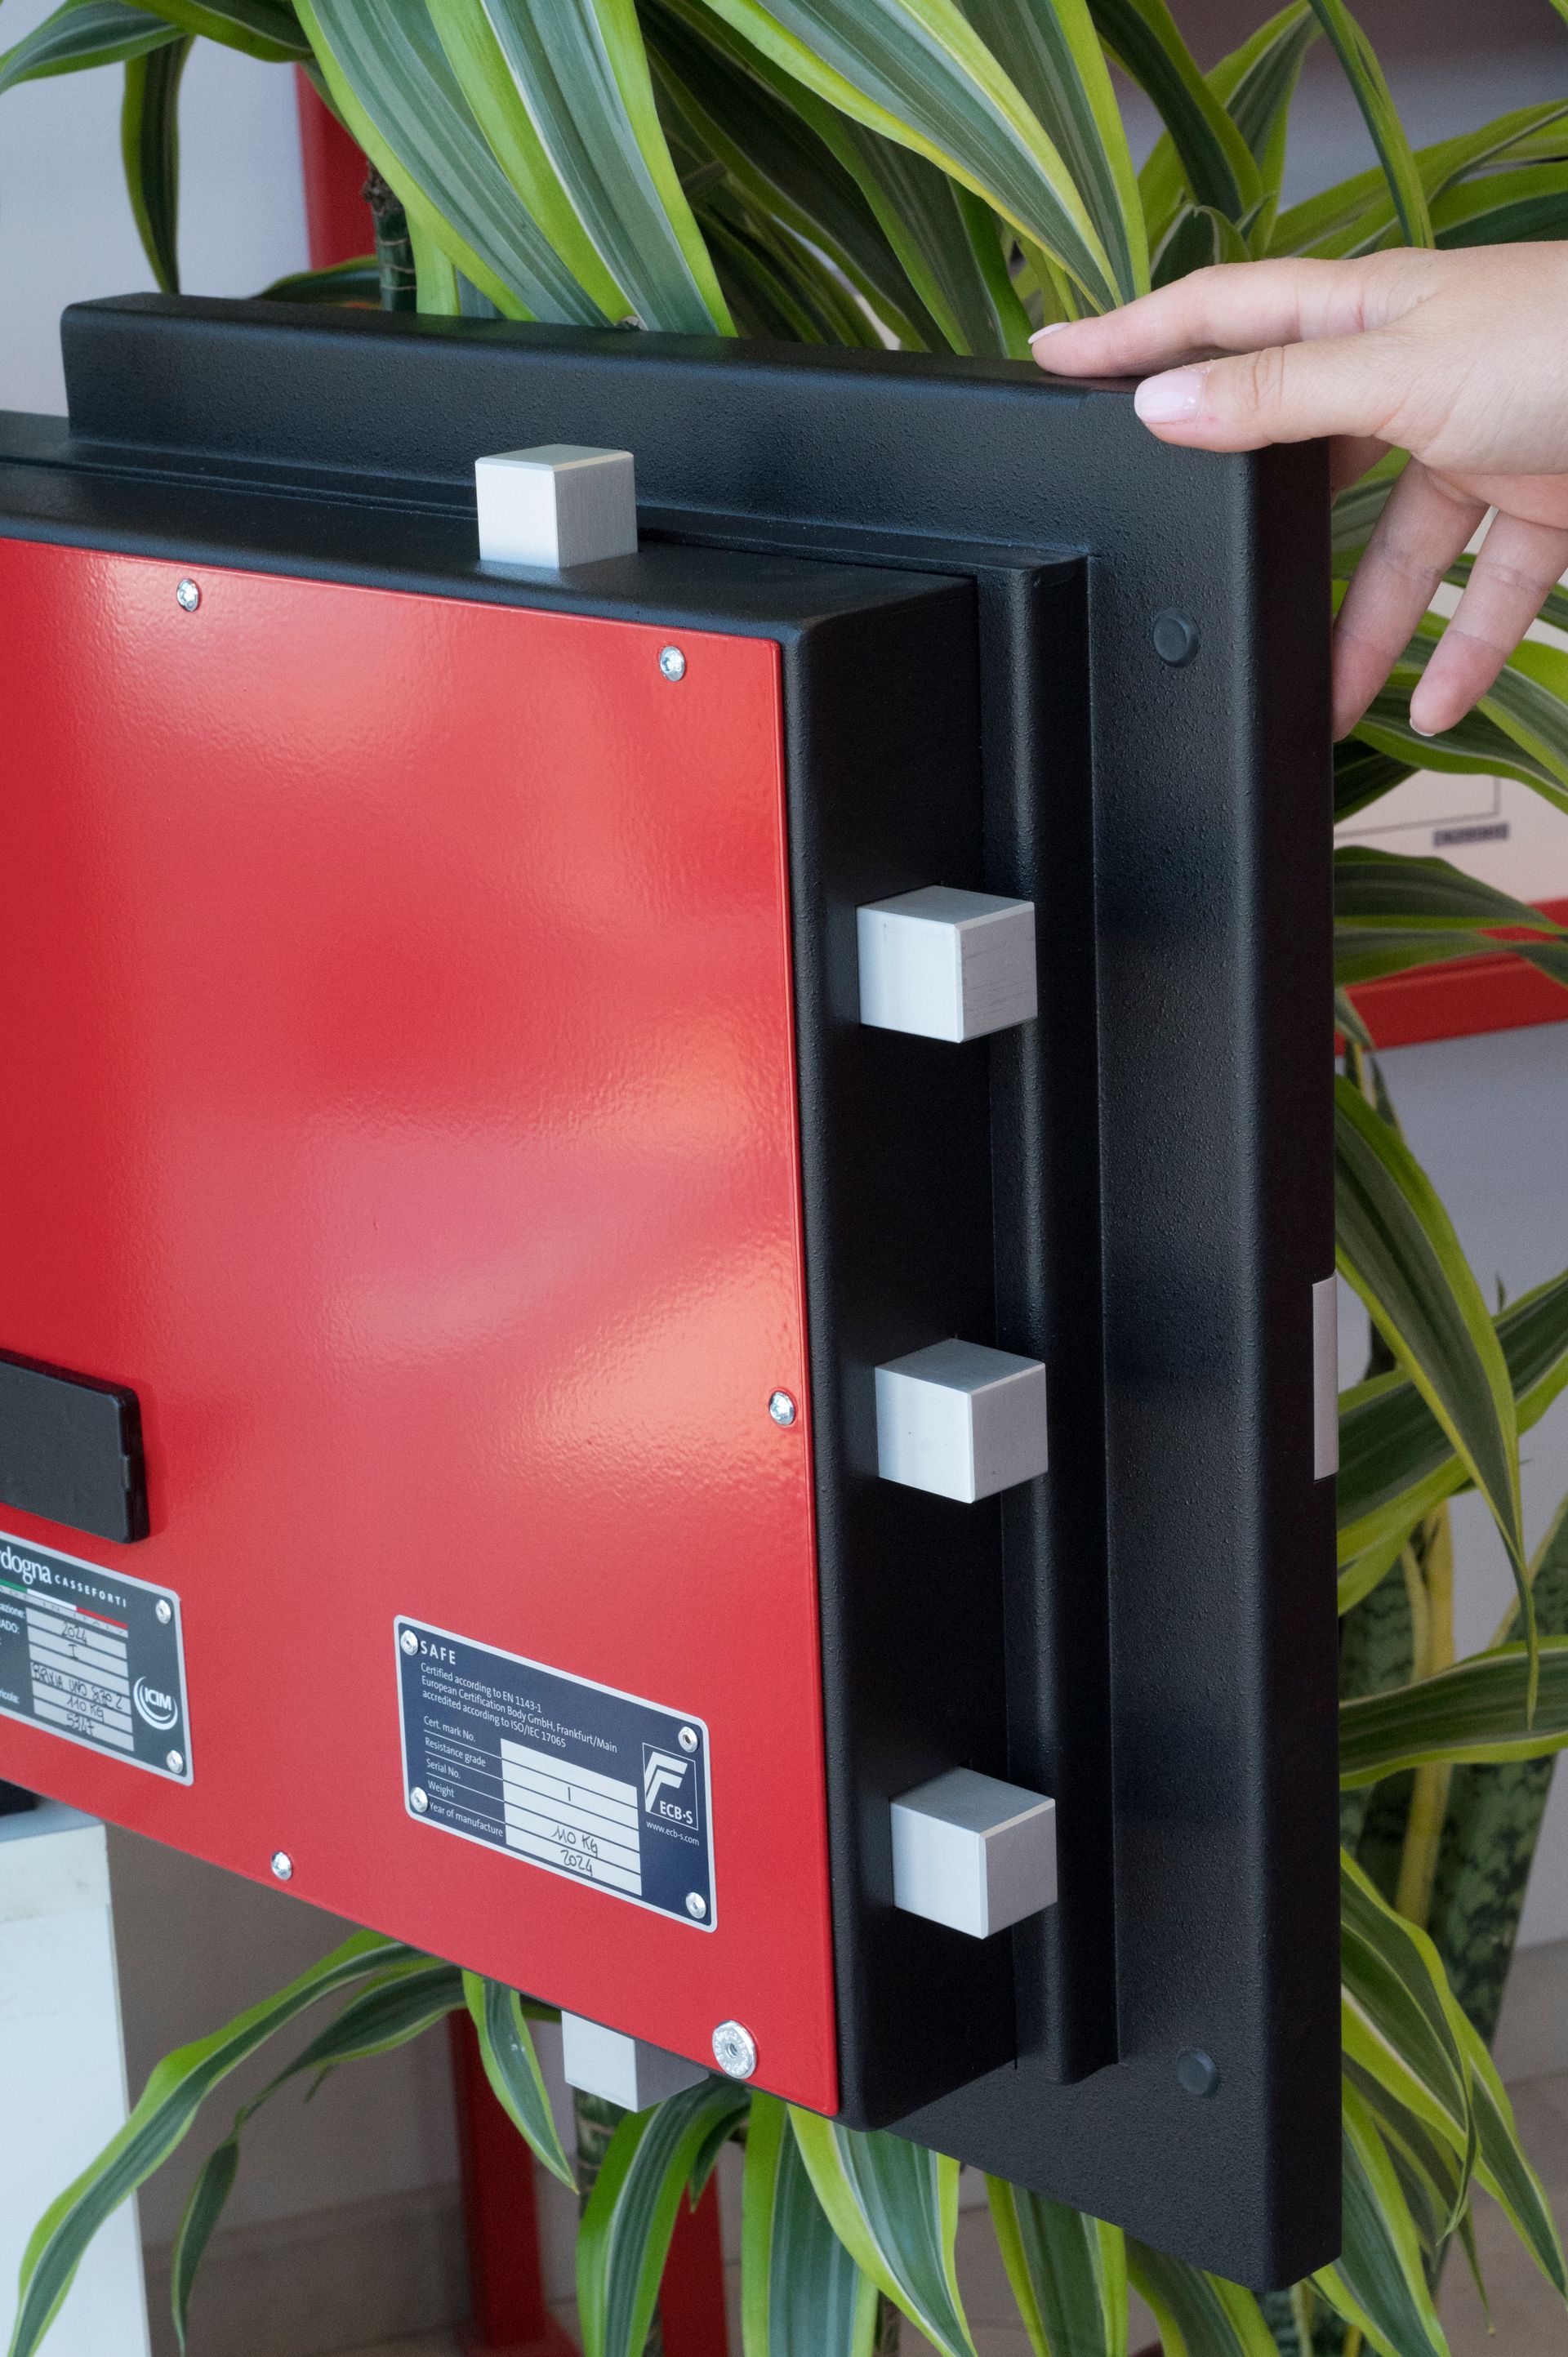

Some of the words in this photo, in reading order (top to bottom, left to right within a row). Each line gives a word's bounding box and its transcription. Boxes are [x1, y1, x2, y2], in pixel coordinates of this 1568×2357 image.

[0, 1546, 52, 1585] dogna
[55, 1574, 127, 1608] CASSEFORTI
[0, 1619, 20, 1634] ADO:
[62, 1621, 87, 1646] 2024
[420, 1640, 456, 1664] SAFE
[145, 1687, 172, 1710] ICIM
[421, 1662, 452, 1682] Certified
[454, 1676, 492, 1698] according
[492, 1688, 501, 1699] to
[502, 1691, 514, 1703] EN
[515, 1695, 542, 1713] 1143-1
[421, 1675, 457, 1695] European
[458, 1689, 506, 1713] Certification
[507, 1706, 526, 1723] Body
[528, 1713, 555, 1732] GmbH,
[556, 1723, 617, 1753] Frankfurt/Main
[422, 1690, 461, 1710] accredited
[462, 1704, 500, 1727] according
[501, 1716, 510, 1727] to
[510, 1720, 540, 1739] ISO/IEC
[541, 1731, 566, 1748] 17065
[424, 1716, 441, 1730] Cert.
[443, 1725, 461, 1737] mark
[462, 1729, 476, 1742] No.
[425, 1737, 463, 1759] Resistance
[465, 1753, 486, 1767] grade
[426, 1758, 447, 1773] Serial
[448, 1767, 461, 1779] No.
[427, 1780, 454, 1798] Weight
[430, 1801, 444, 1815] Year
[446, 1809, 454, 1818] of
[456, 1812, 503, 1837] manufacture
[646, 1820, 699, 1847] www.ecb-s.com
[560, 1849, 593, 1877] 2024
